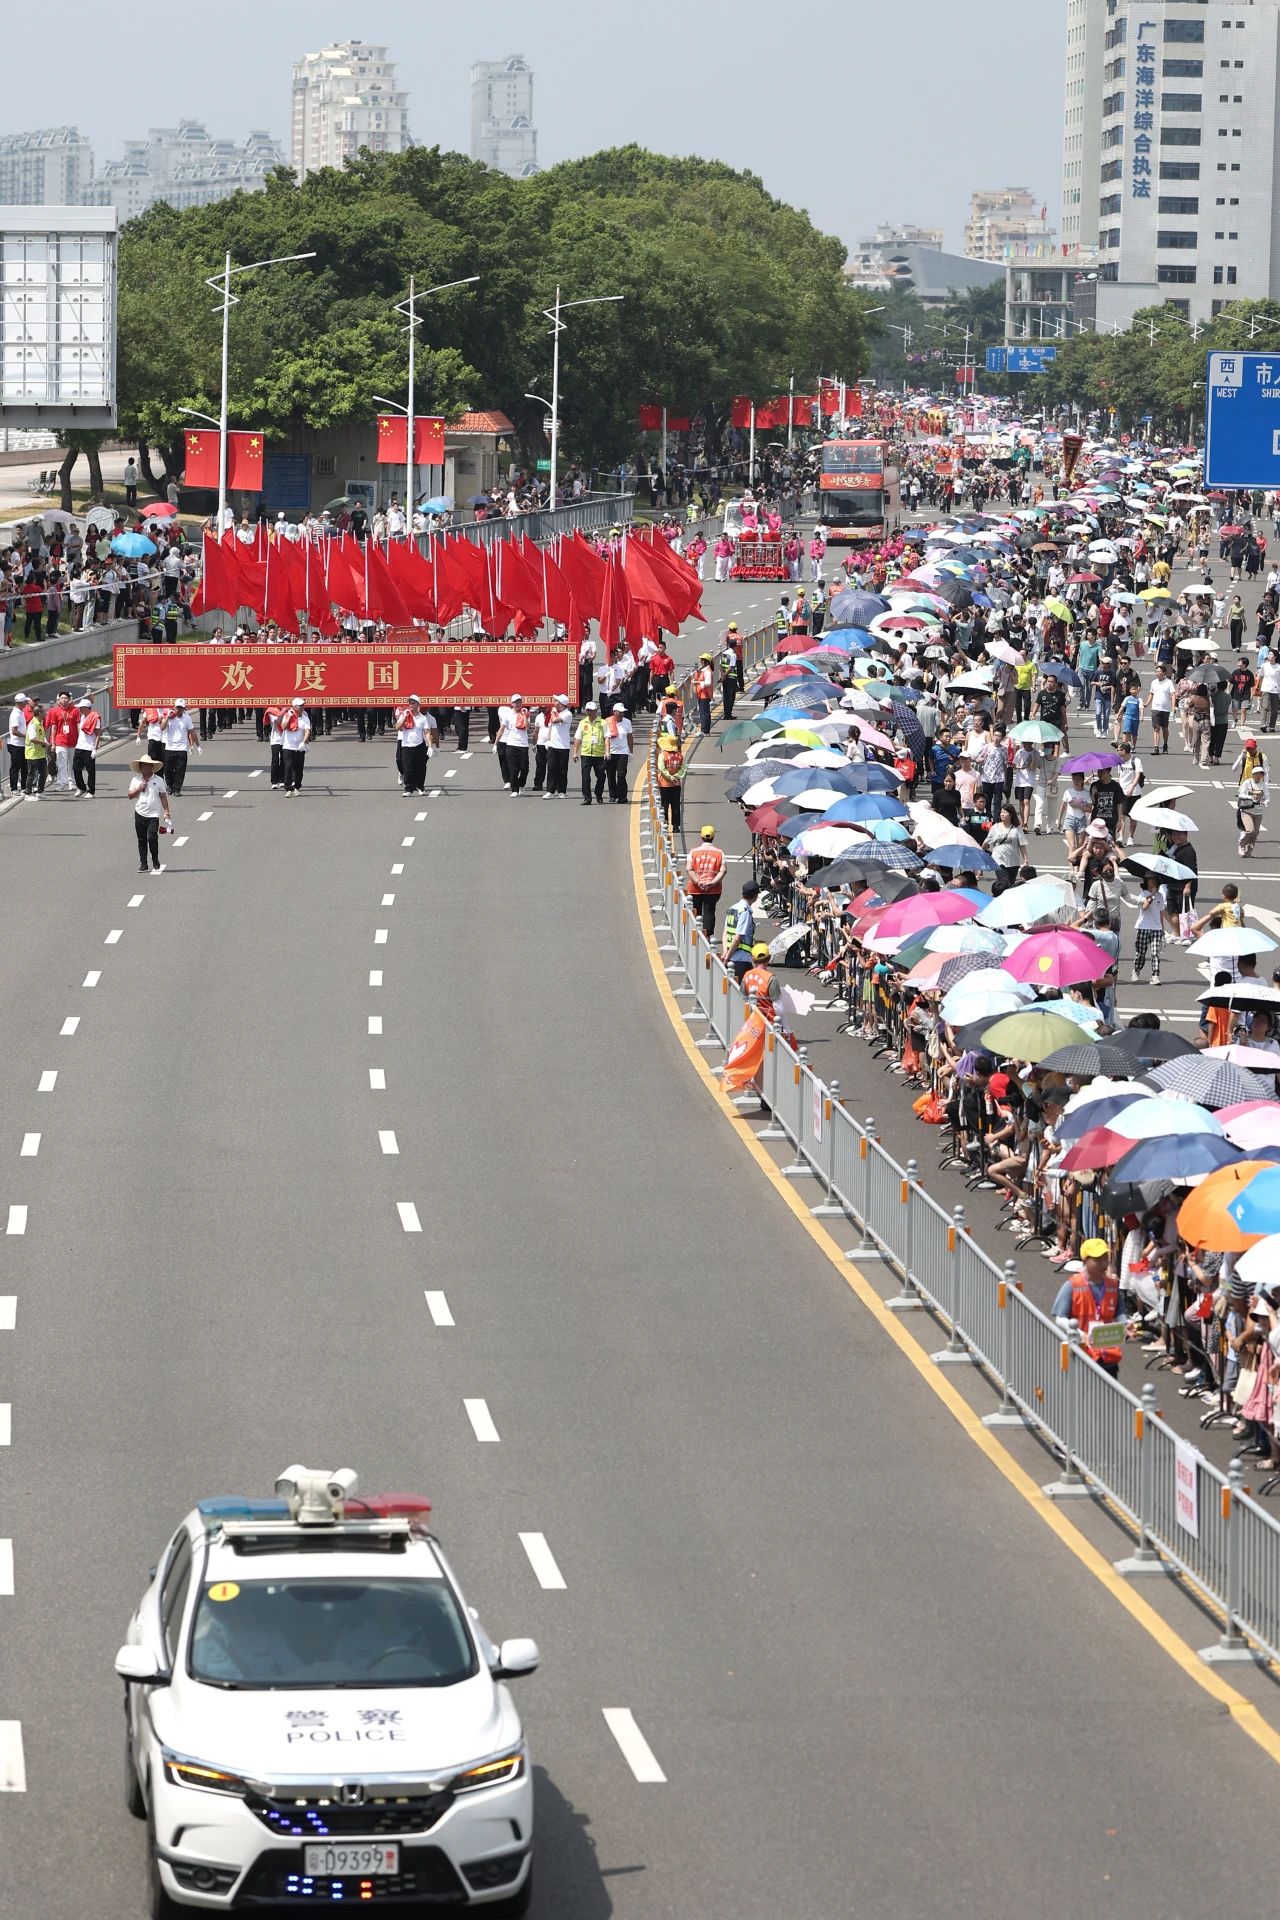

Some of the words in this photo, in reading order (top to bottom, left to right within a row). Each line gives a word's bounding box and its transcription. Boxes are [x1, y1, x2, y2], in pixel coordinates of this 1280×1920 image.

[1132, 20, 1157, 199] 广东海洋综合执法
[1220, 358, 1235, 373] 西
[1216, 388, 1238, 398] WEST
[220, 659, 475, 691] 欢度国庆
[285, 1708, 403, 1728] 警察
[287, 1730, 407, 1743] POLICE
